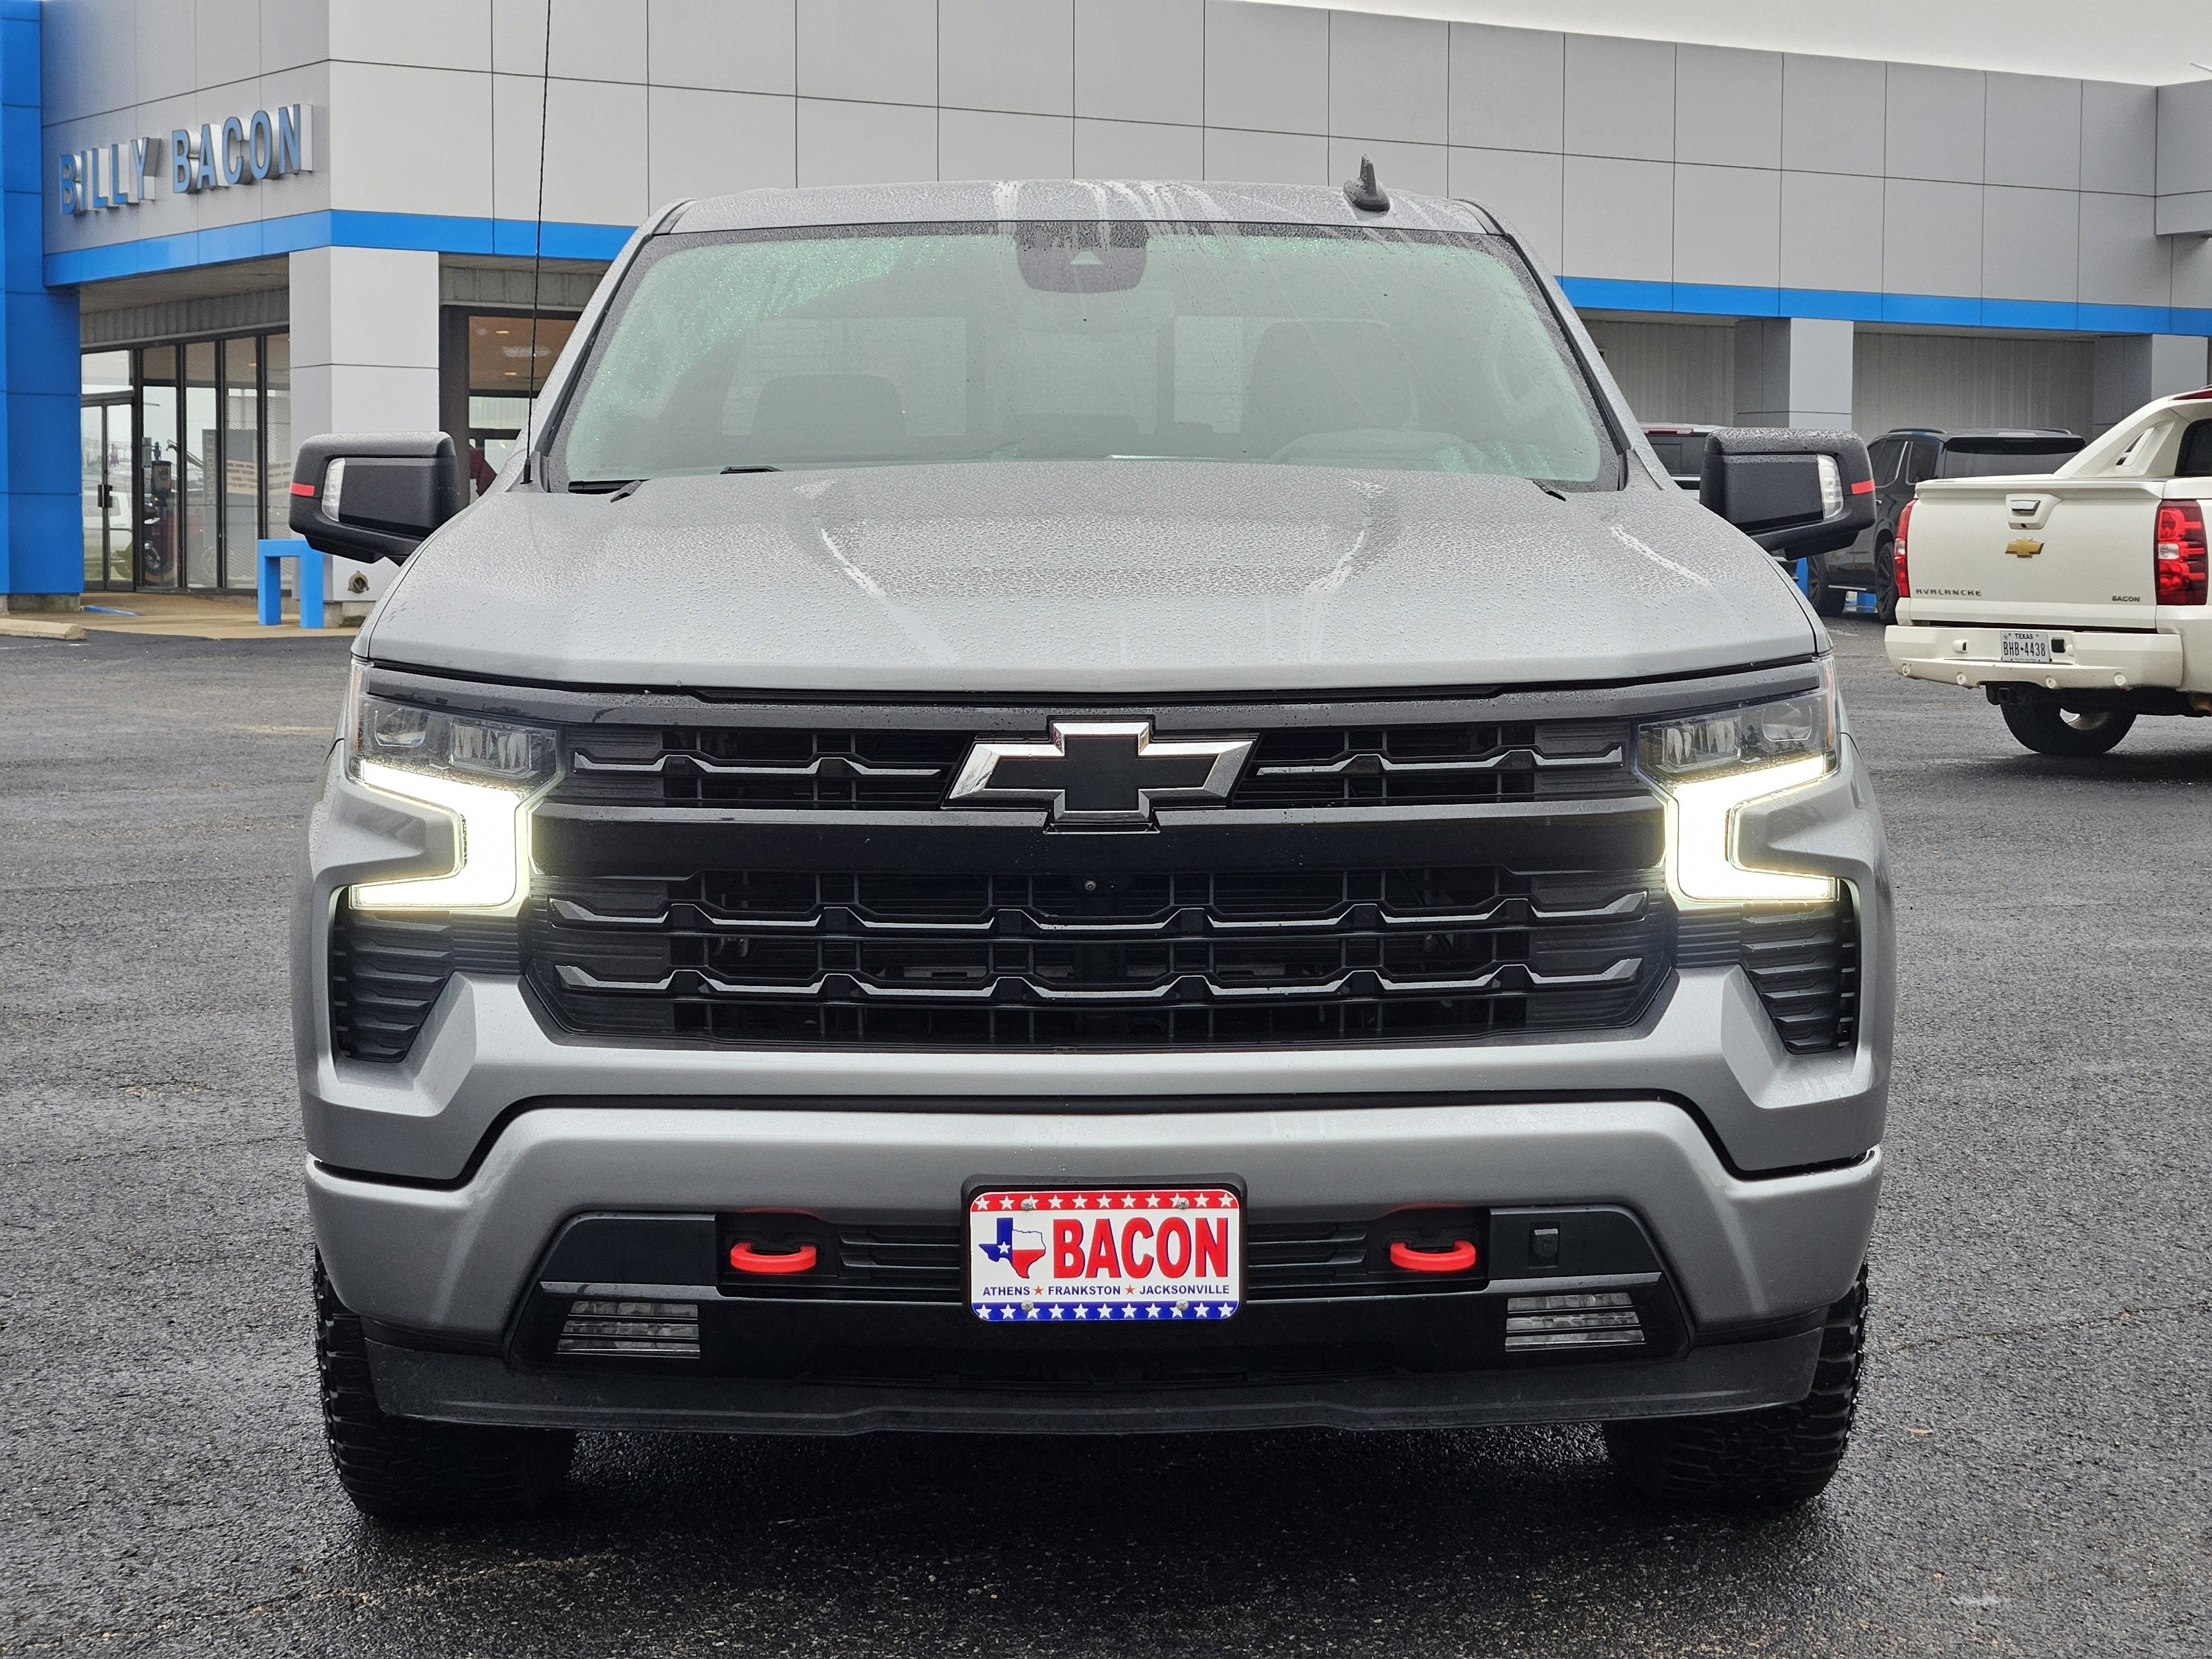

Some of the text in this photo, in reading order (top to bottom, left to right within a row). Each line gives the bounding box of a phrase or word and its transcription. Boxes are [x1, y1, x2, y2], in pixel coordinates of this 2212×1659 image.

[60, 103, 310, 215] BILLY BACON
[1053, 1217, 1229, 1279] BACON
[983, 1284, 1230, 1296] ATHENS FRANKSTON JACKSONVILLE
